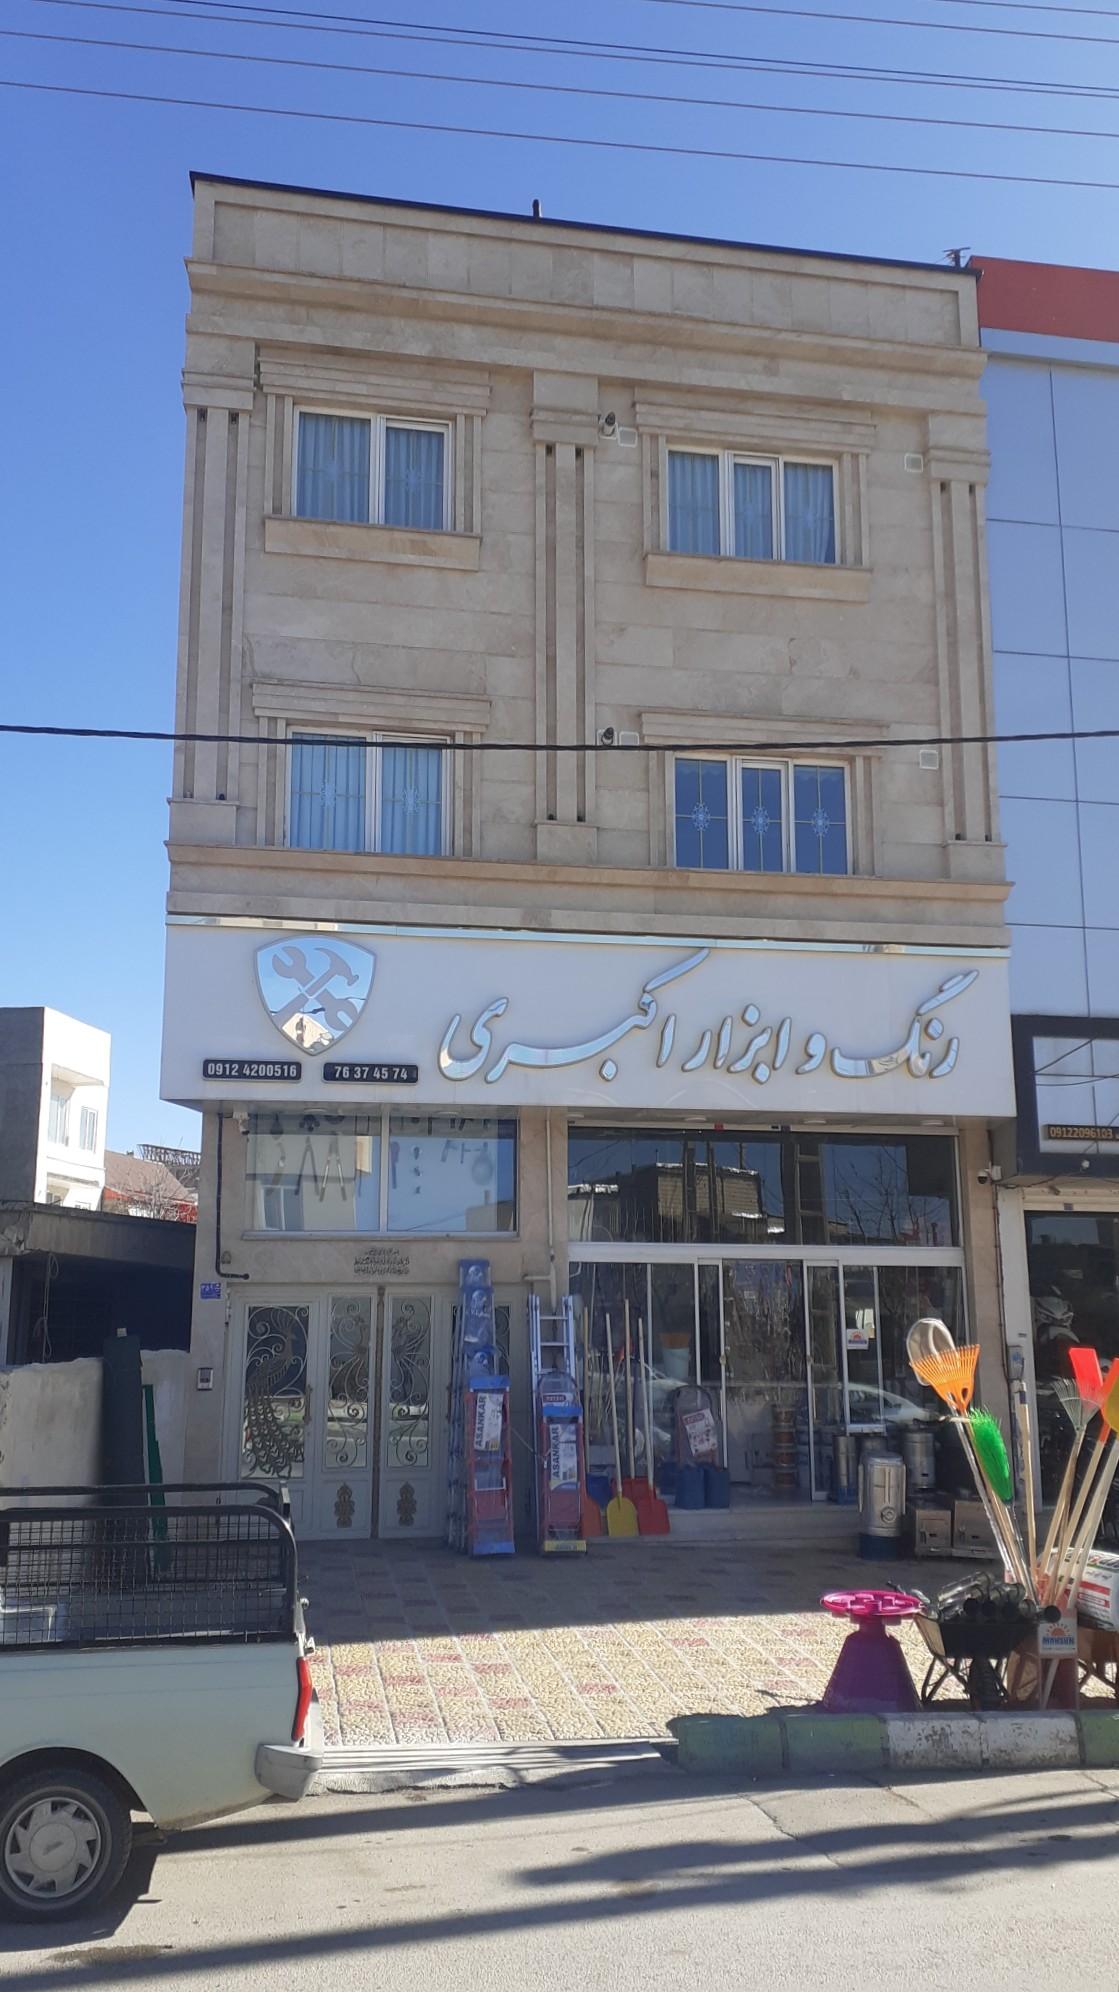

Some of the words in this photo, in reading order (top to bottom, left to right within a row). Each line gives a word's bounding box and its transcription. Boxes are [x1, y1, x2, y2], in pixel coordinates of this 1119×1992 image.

[438, 947, 711, 1084] اکبری
[830, 969, 980, 1079] رنگ
[207, 1062, 239, 1077] 0912
[242, 1063, 298, 1078] 4200516
[682, 1003, 793, 1085] ابزار
[796, 1032, 827, 1076] و
[334, 1065, 350, 1079] 76
[353, 1066, 368, 1080] 37
[372, 1066, 389, 1080] 45
[392, 1067, 409, 1081] 74
[475, 1395, 487, 1448] ASANKAR
[551, 1425, 560, 1479] ASANKAR
